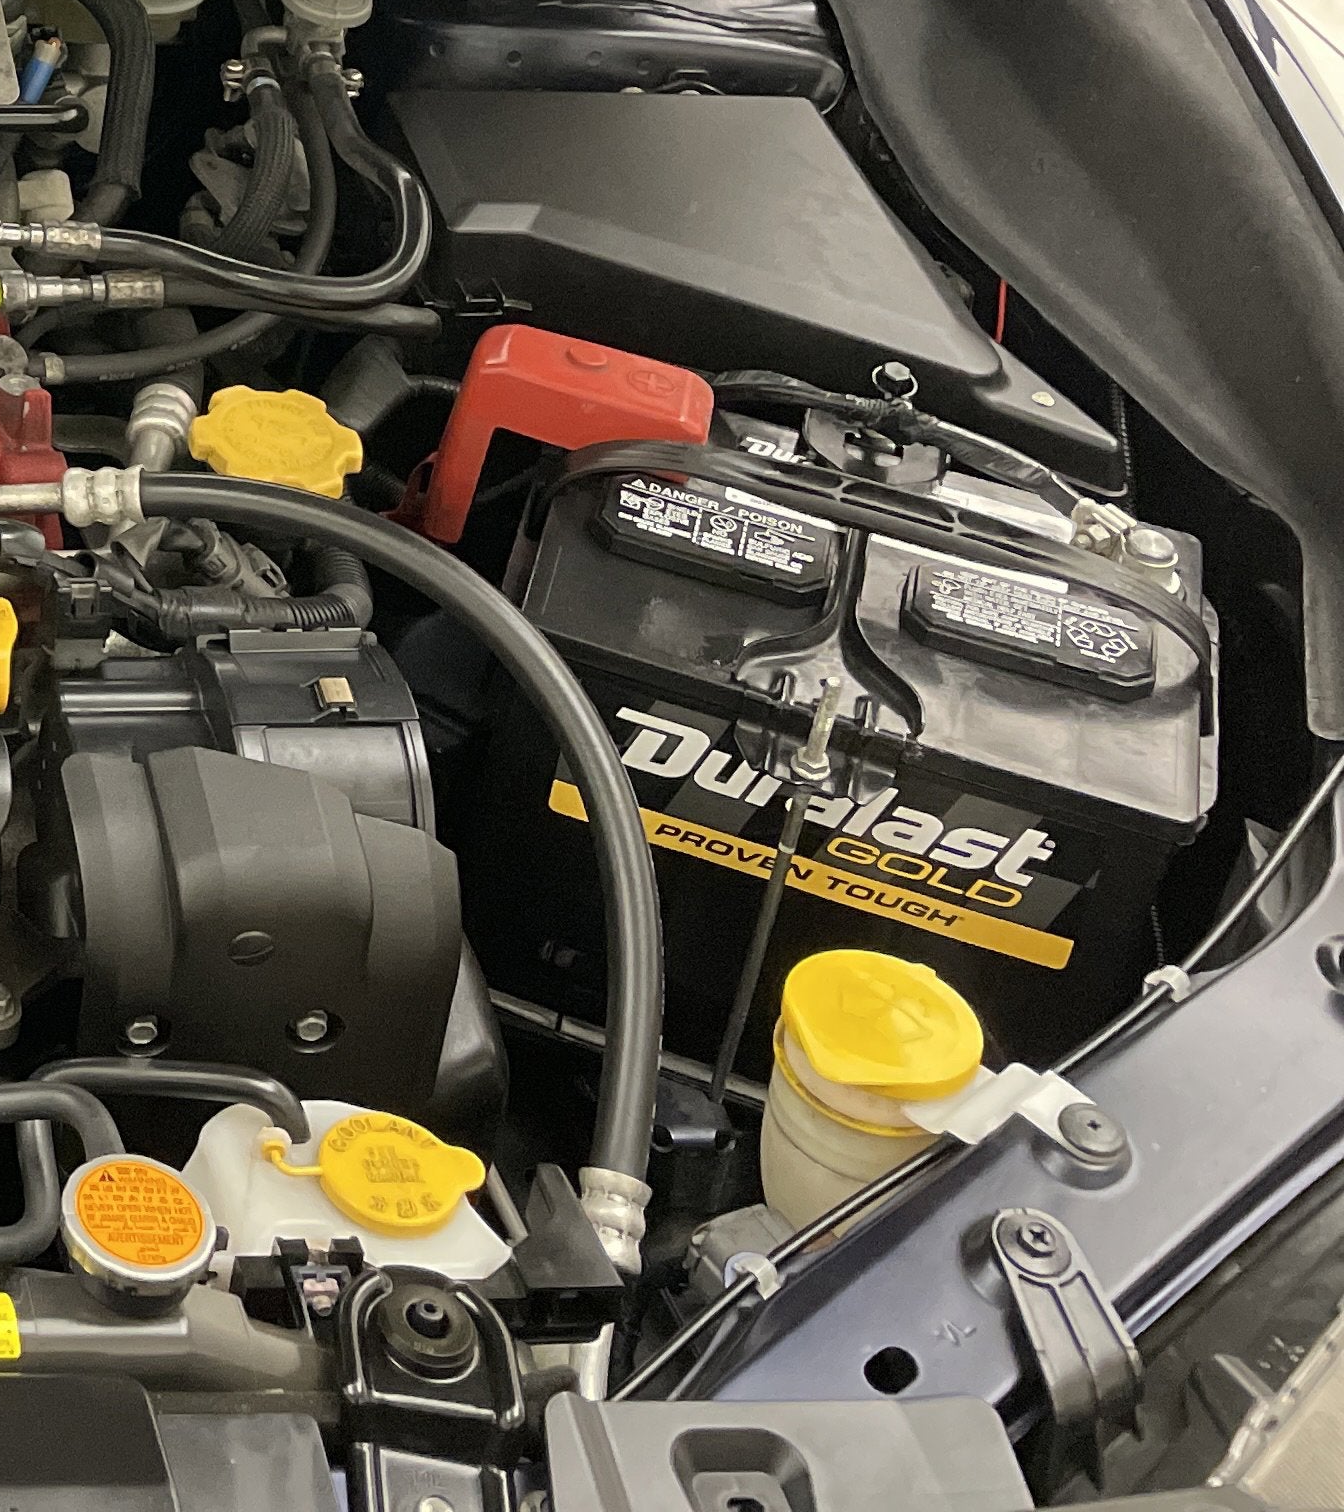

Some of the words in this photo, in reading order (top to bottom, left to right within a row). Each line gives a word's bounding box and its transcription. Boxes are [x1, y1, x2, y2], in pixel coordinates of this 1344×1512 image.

[648, 481, 721, 510] DANGER
[738, 509, 803, 535] POISON
[653, 823, 813, 881] PROVEN
[826, 874, 959, 928] TOUGH
[826, 835, 1023, 909] GOLD
